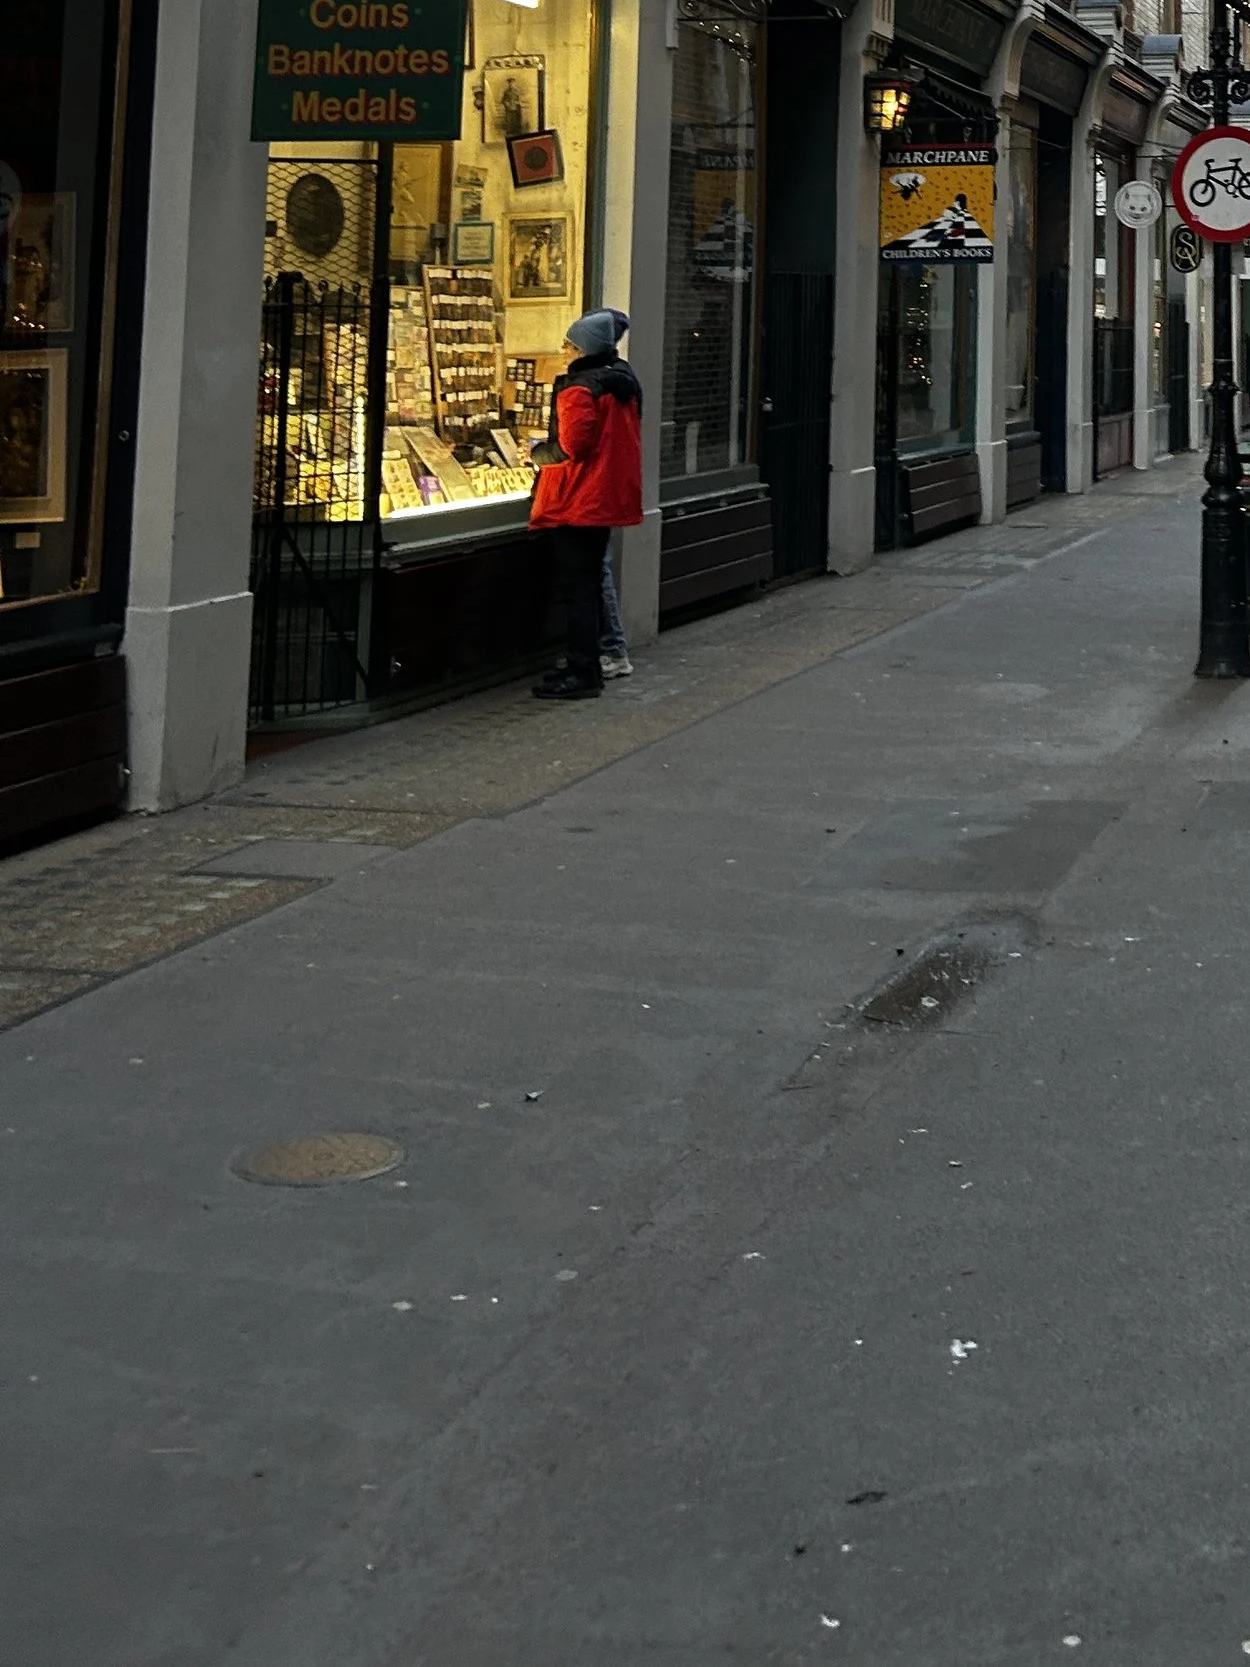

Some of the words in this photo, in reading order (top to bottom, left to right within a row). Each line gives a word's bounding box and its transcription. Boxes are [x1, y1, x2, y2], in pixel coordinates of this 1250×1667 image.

[267, 43, 450, 77] Banknotes
[291, 88, 417, 124] Medals
[885, 150, 990, 164] MARCHPANE
[881, 248, 952, 259] CHILDREN'S
[952, 247, 993, 258] BOOKS
